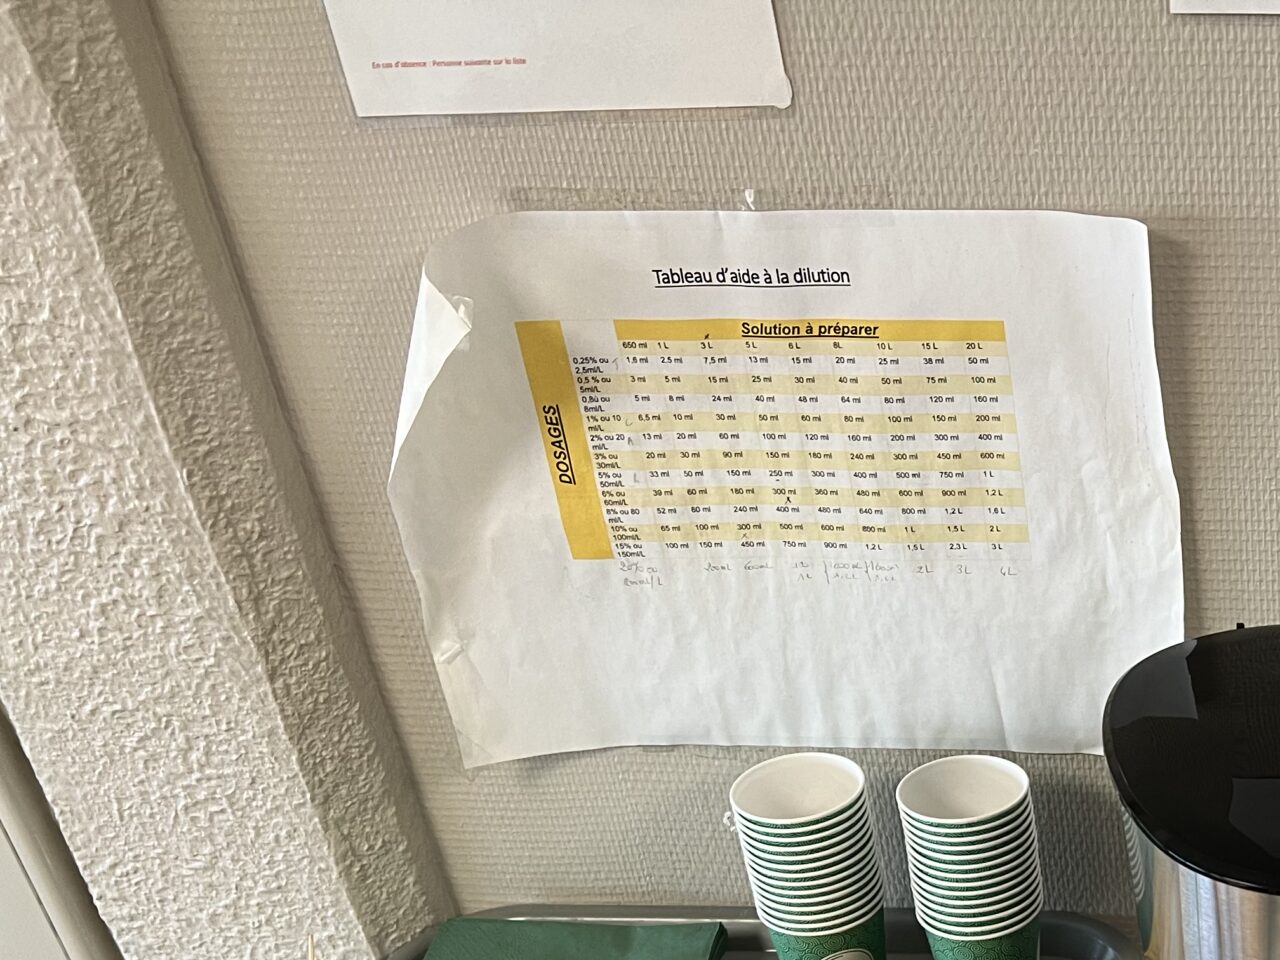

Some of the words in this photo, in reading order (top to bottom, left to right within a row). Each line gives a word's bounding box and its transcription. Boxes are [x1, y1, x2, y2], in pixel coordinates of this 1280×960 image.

[652, 268, 712, 284] Tableau
[764, 269, 772, 284] à
[776, 269, 789, 284] la
[793, 268, 850, 283] dilution
[742, 322, 800, 335] Solution
[806, 322, 814, 335] à
[818, 323, 879, 337] préparer
[622, 341, 637, 349] 650
[638, 341, 648, 349] ml
[664, 341, 669, 349] L
[700, 341, 706, 349] 3
[707, 341, 713, 349] L
[745, 341, 751, 349] 5
[752, 341, 757, 349] L
[833, 341, 842, 349] 8L
[966, 342, 976, 350] 20
[717, 356, 727, 364] ml
[749, 356, 758, 364] 13
[759, 356, 769, 364] ml
[543, 405, 573, 484] DOSAGES
